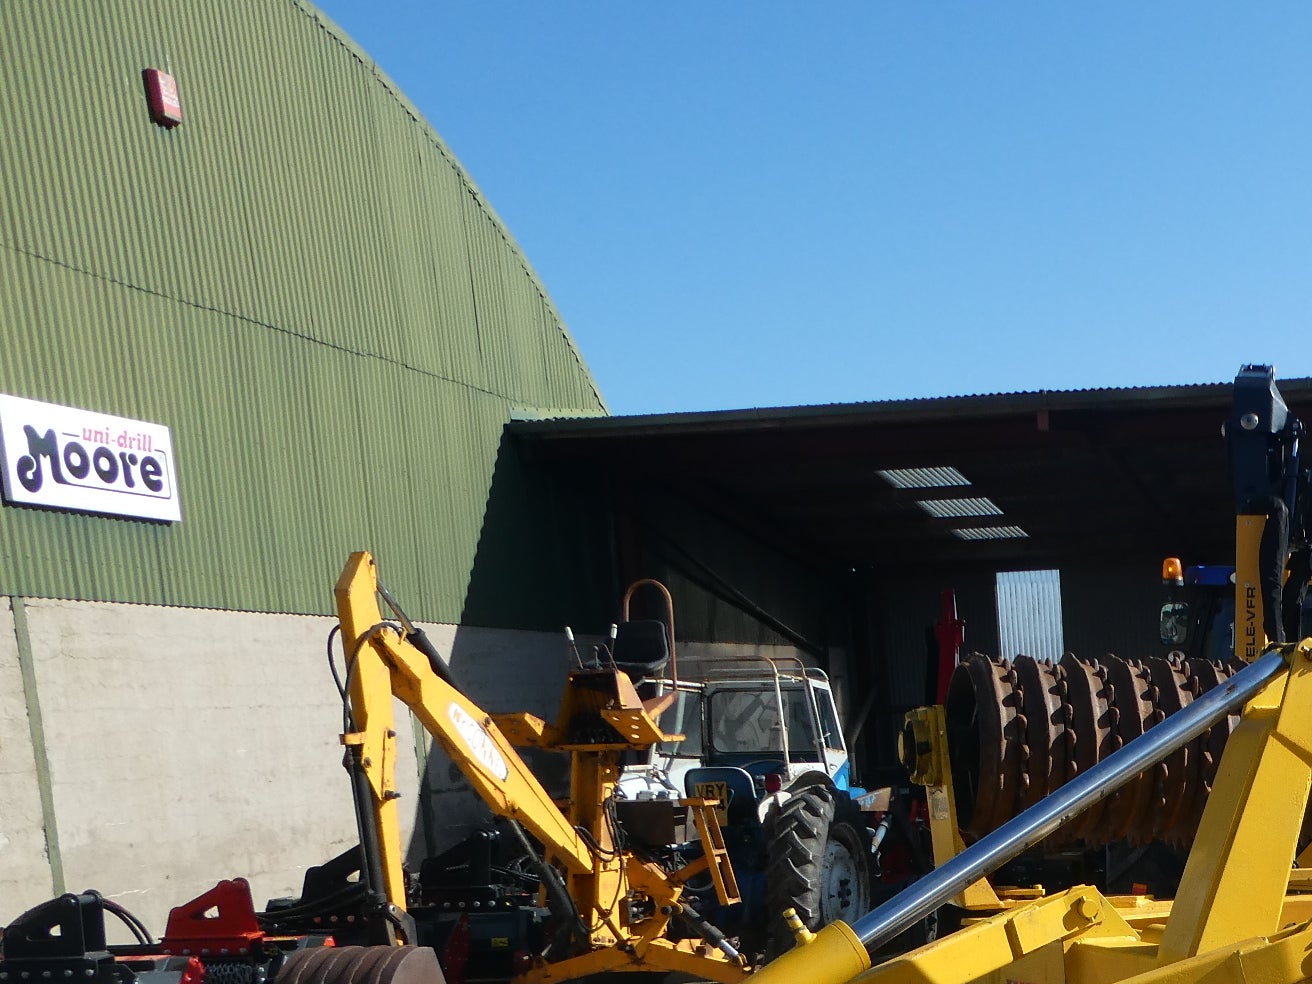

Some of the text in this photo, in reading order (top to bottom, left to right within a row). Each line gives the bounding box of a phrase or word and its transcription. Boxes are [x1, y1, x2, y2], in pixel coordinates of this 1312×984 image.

[16, 424, 164, 493] Moore
[82, 427, 153, 452] uni-drill
[1246, 586, 1257, 662] ELE-VFR
[696, 783, 725, 798] VRY
